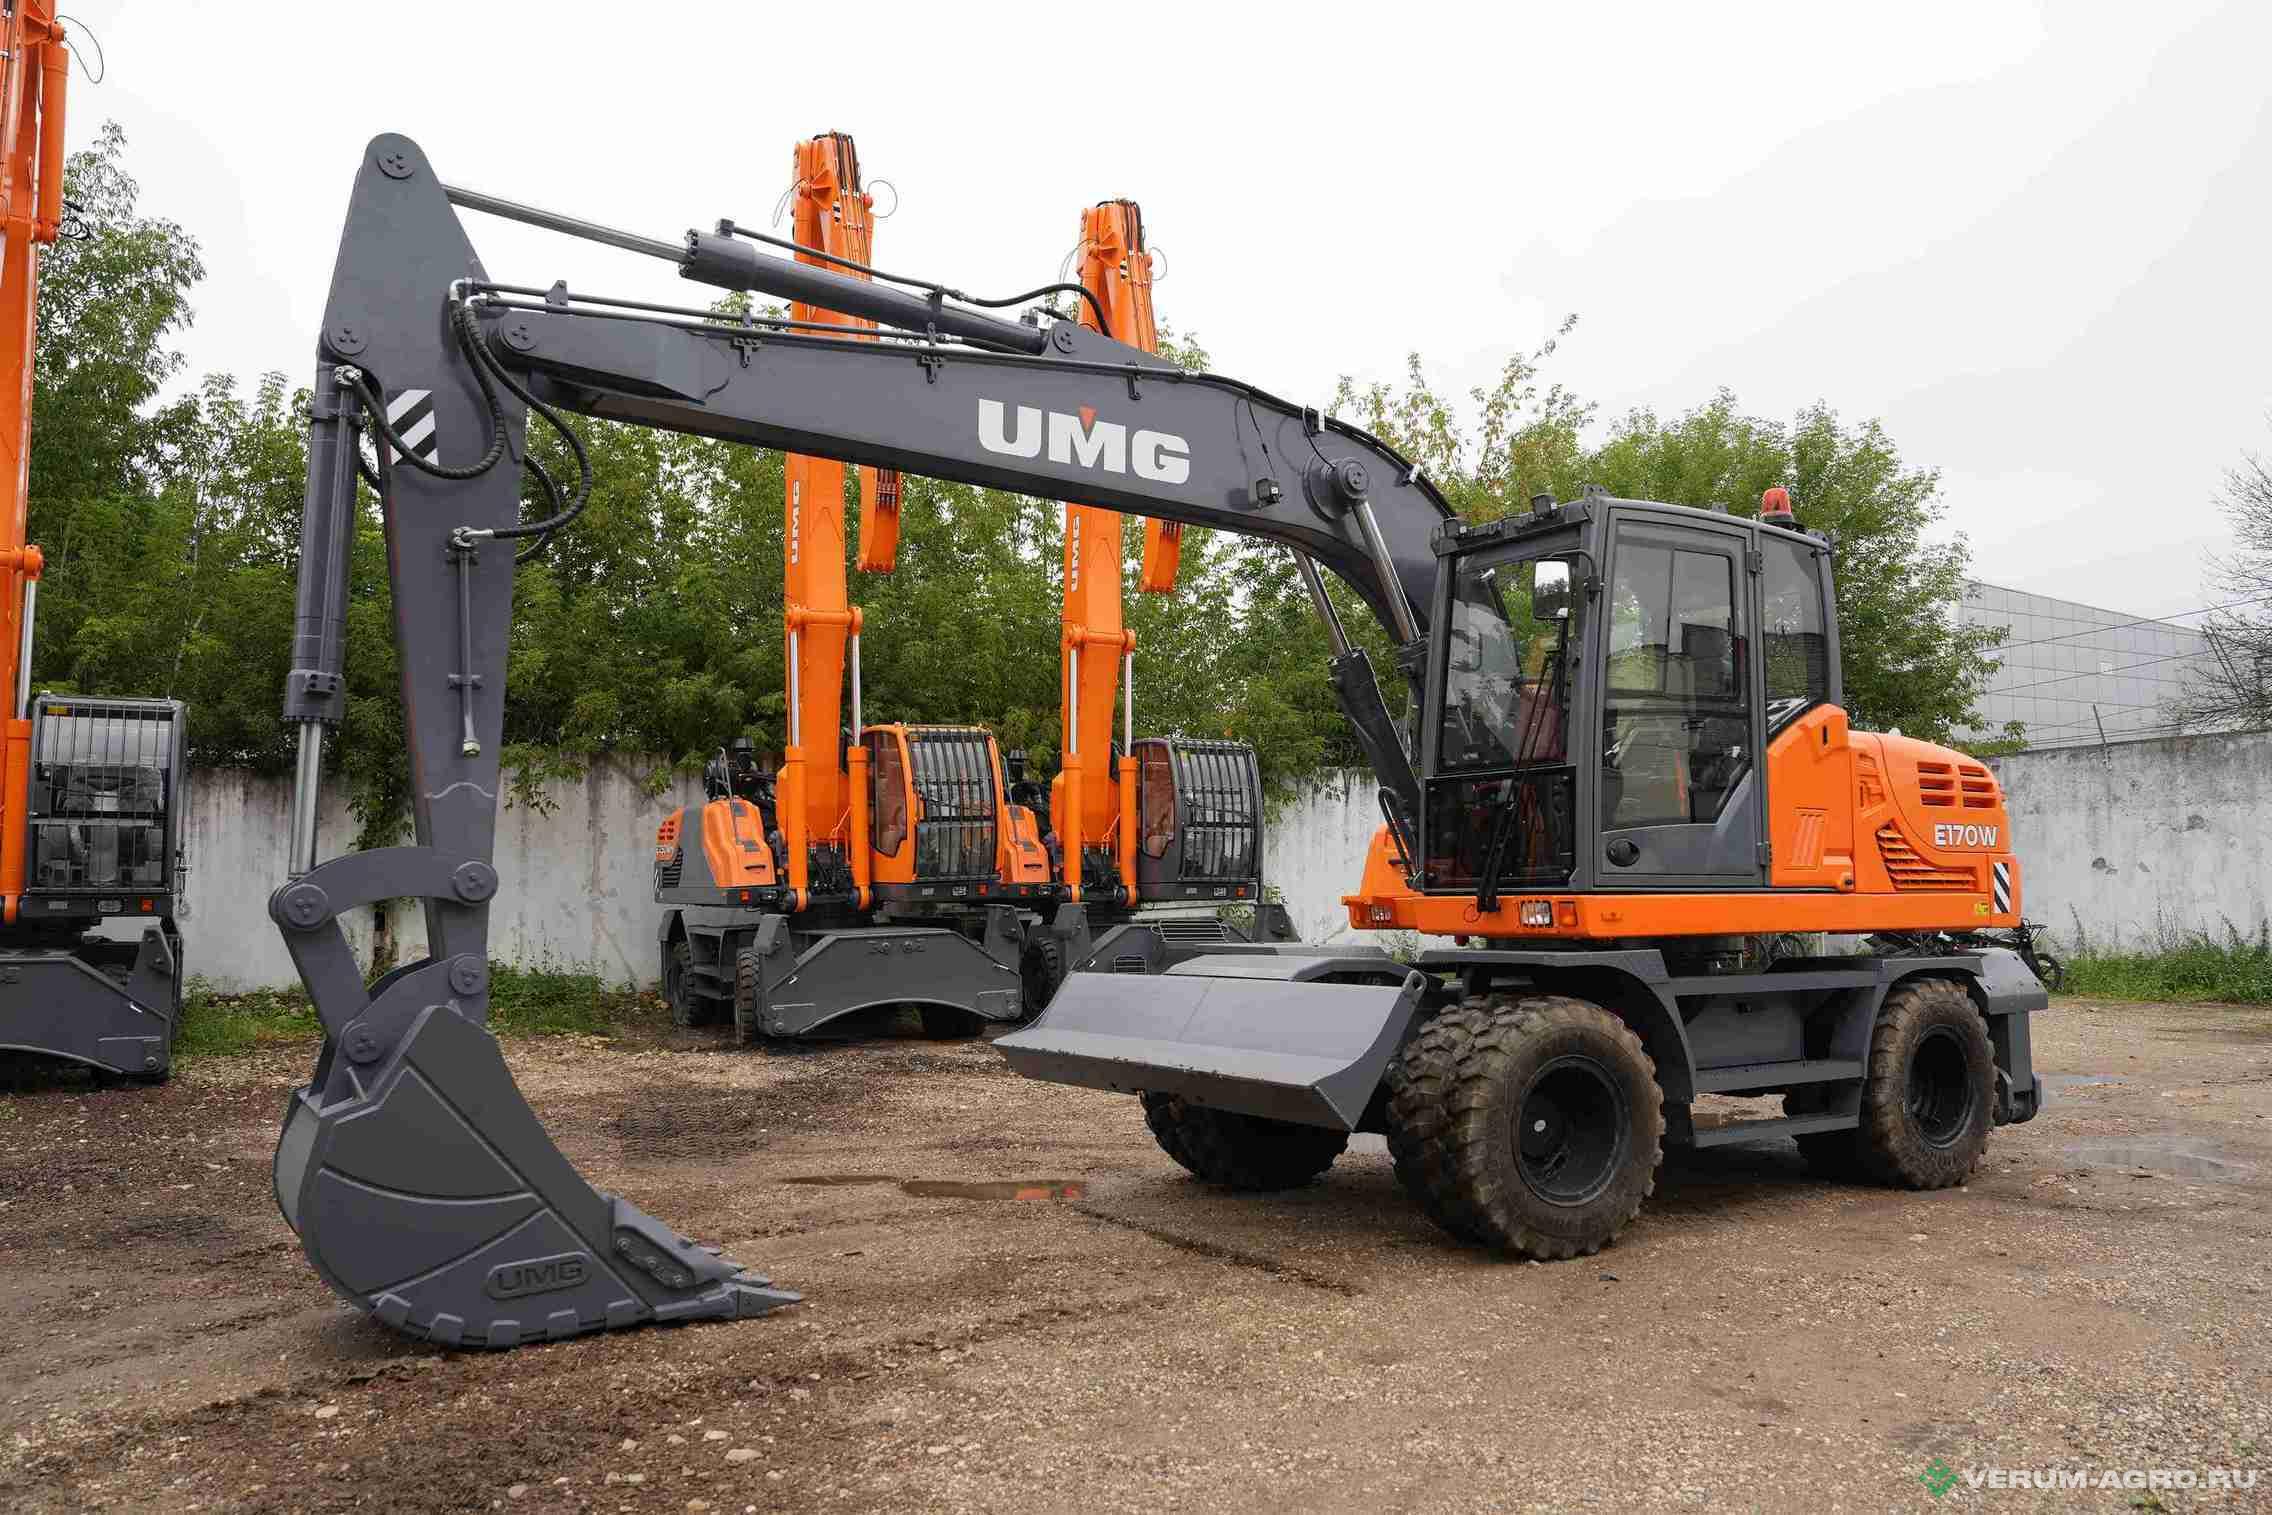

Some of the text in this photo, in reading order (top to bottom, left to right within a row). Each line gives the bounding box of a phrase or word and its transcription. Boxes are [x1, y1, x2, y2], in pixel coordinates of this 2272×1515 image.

[978, 398, 1190, 484] UMG
[791, 479, 800, 564] UMG
[1071, 514, 1080, 592] UMG
[1934, 823, 1998, 847] E170W
[496, 1262, 584, 1292] UMG
